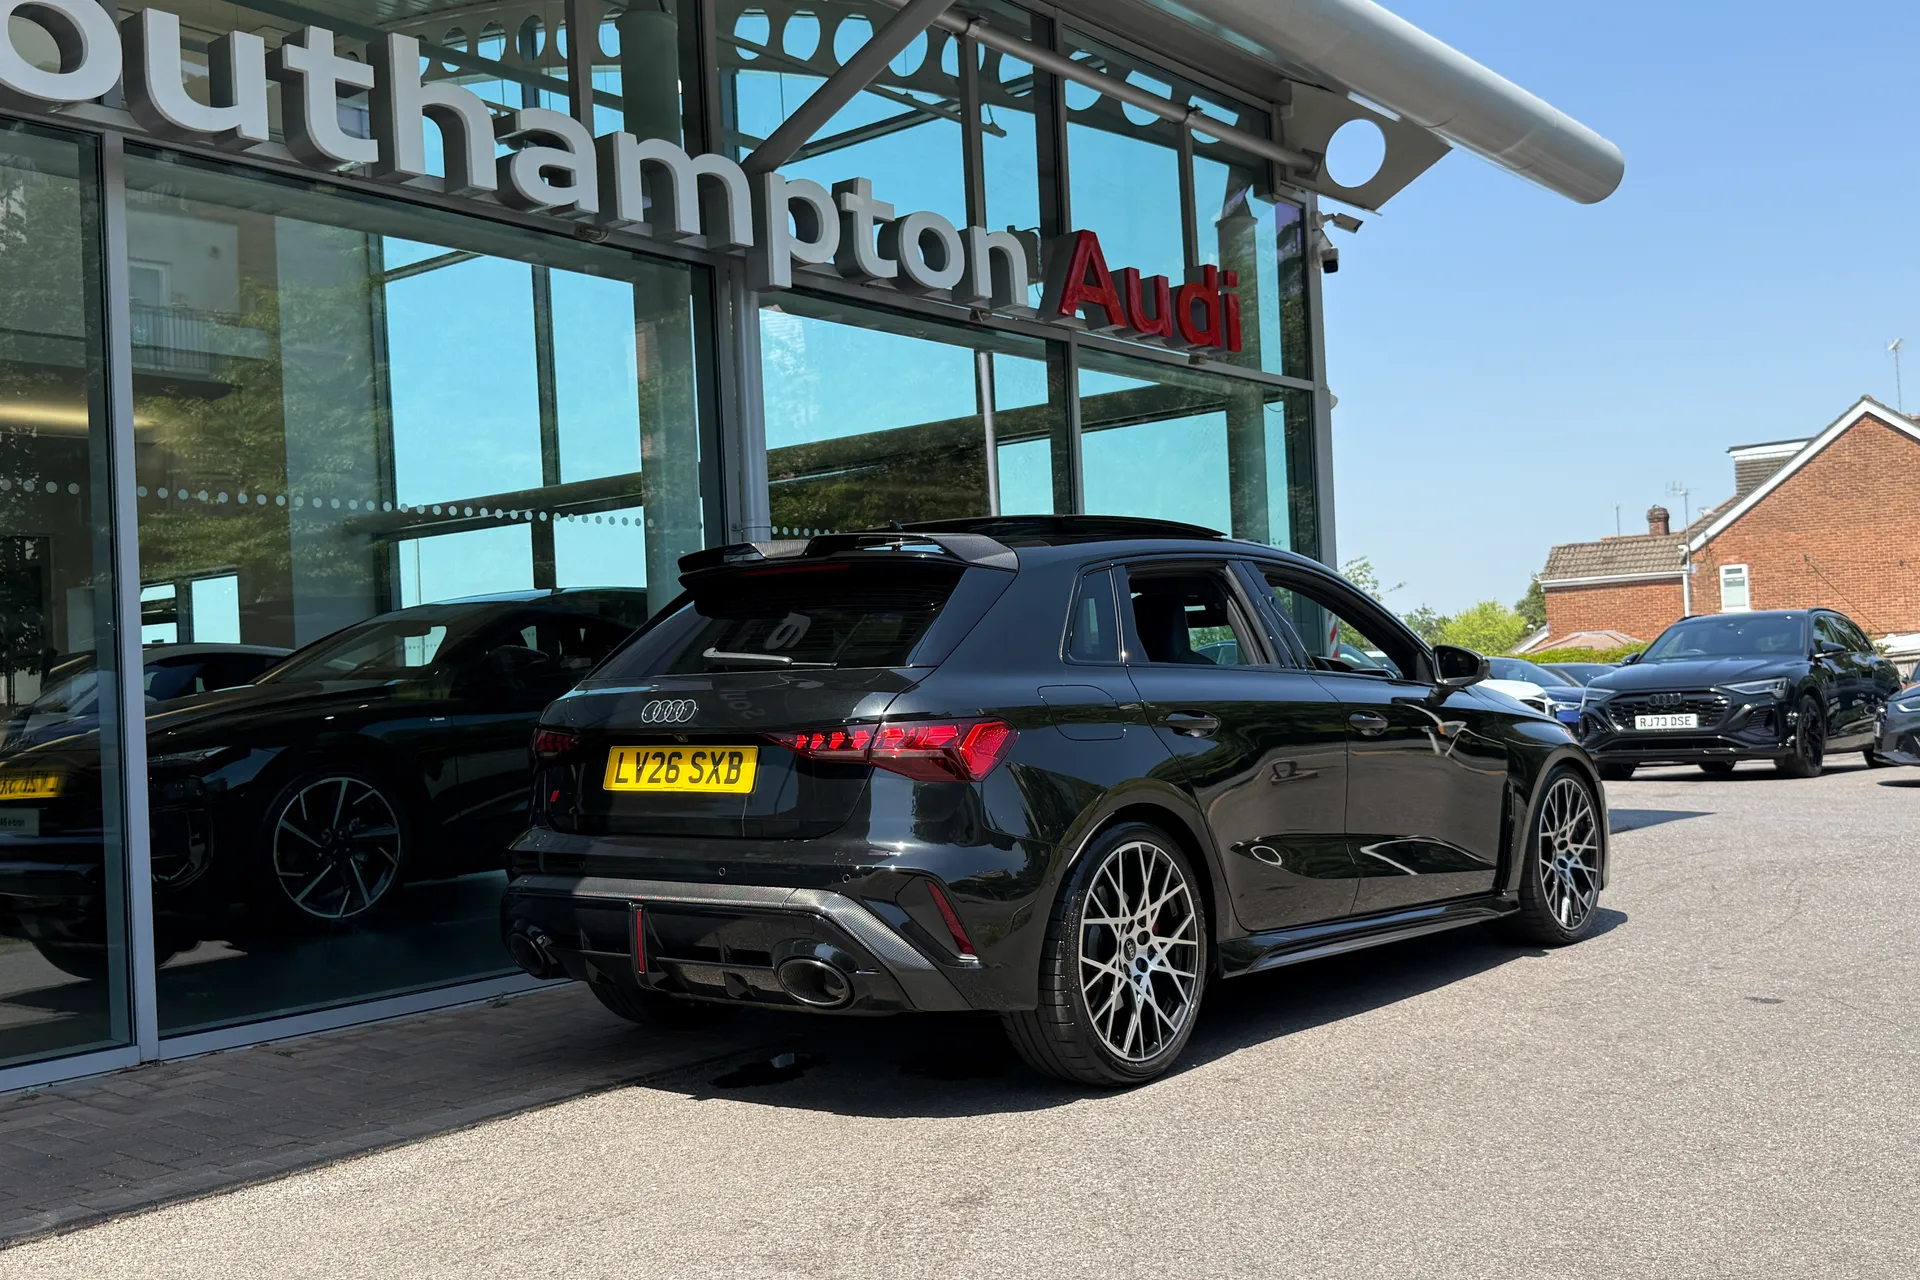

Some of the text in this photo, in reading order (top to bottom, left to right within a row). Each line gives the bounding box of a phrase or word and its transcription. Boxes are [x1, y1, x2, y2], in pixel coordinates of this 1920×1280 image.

[1056, 229, 1242, 353] Audi
[1640, 716, 1691, 727] RJ73 DSE
[614, 751, 744, 785] LV26 SXB
